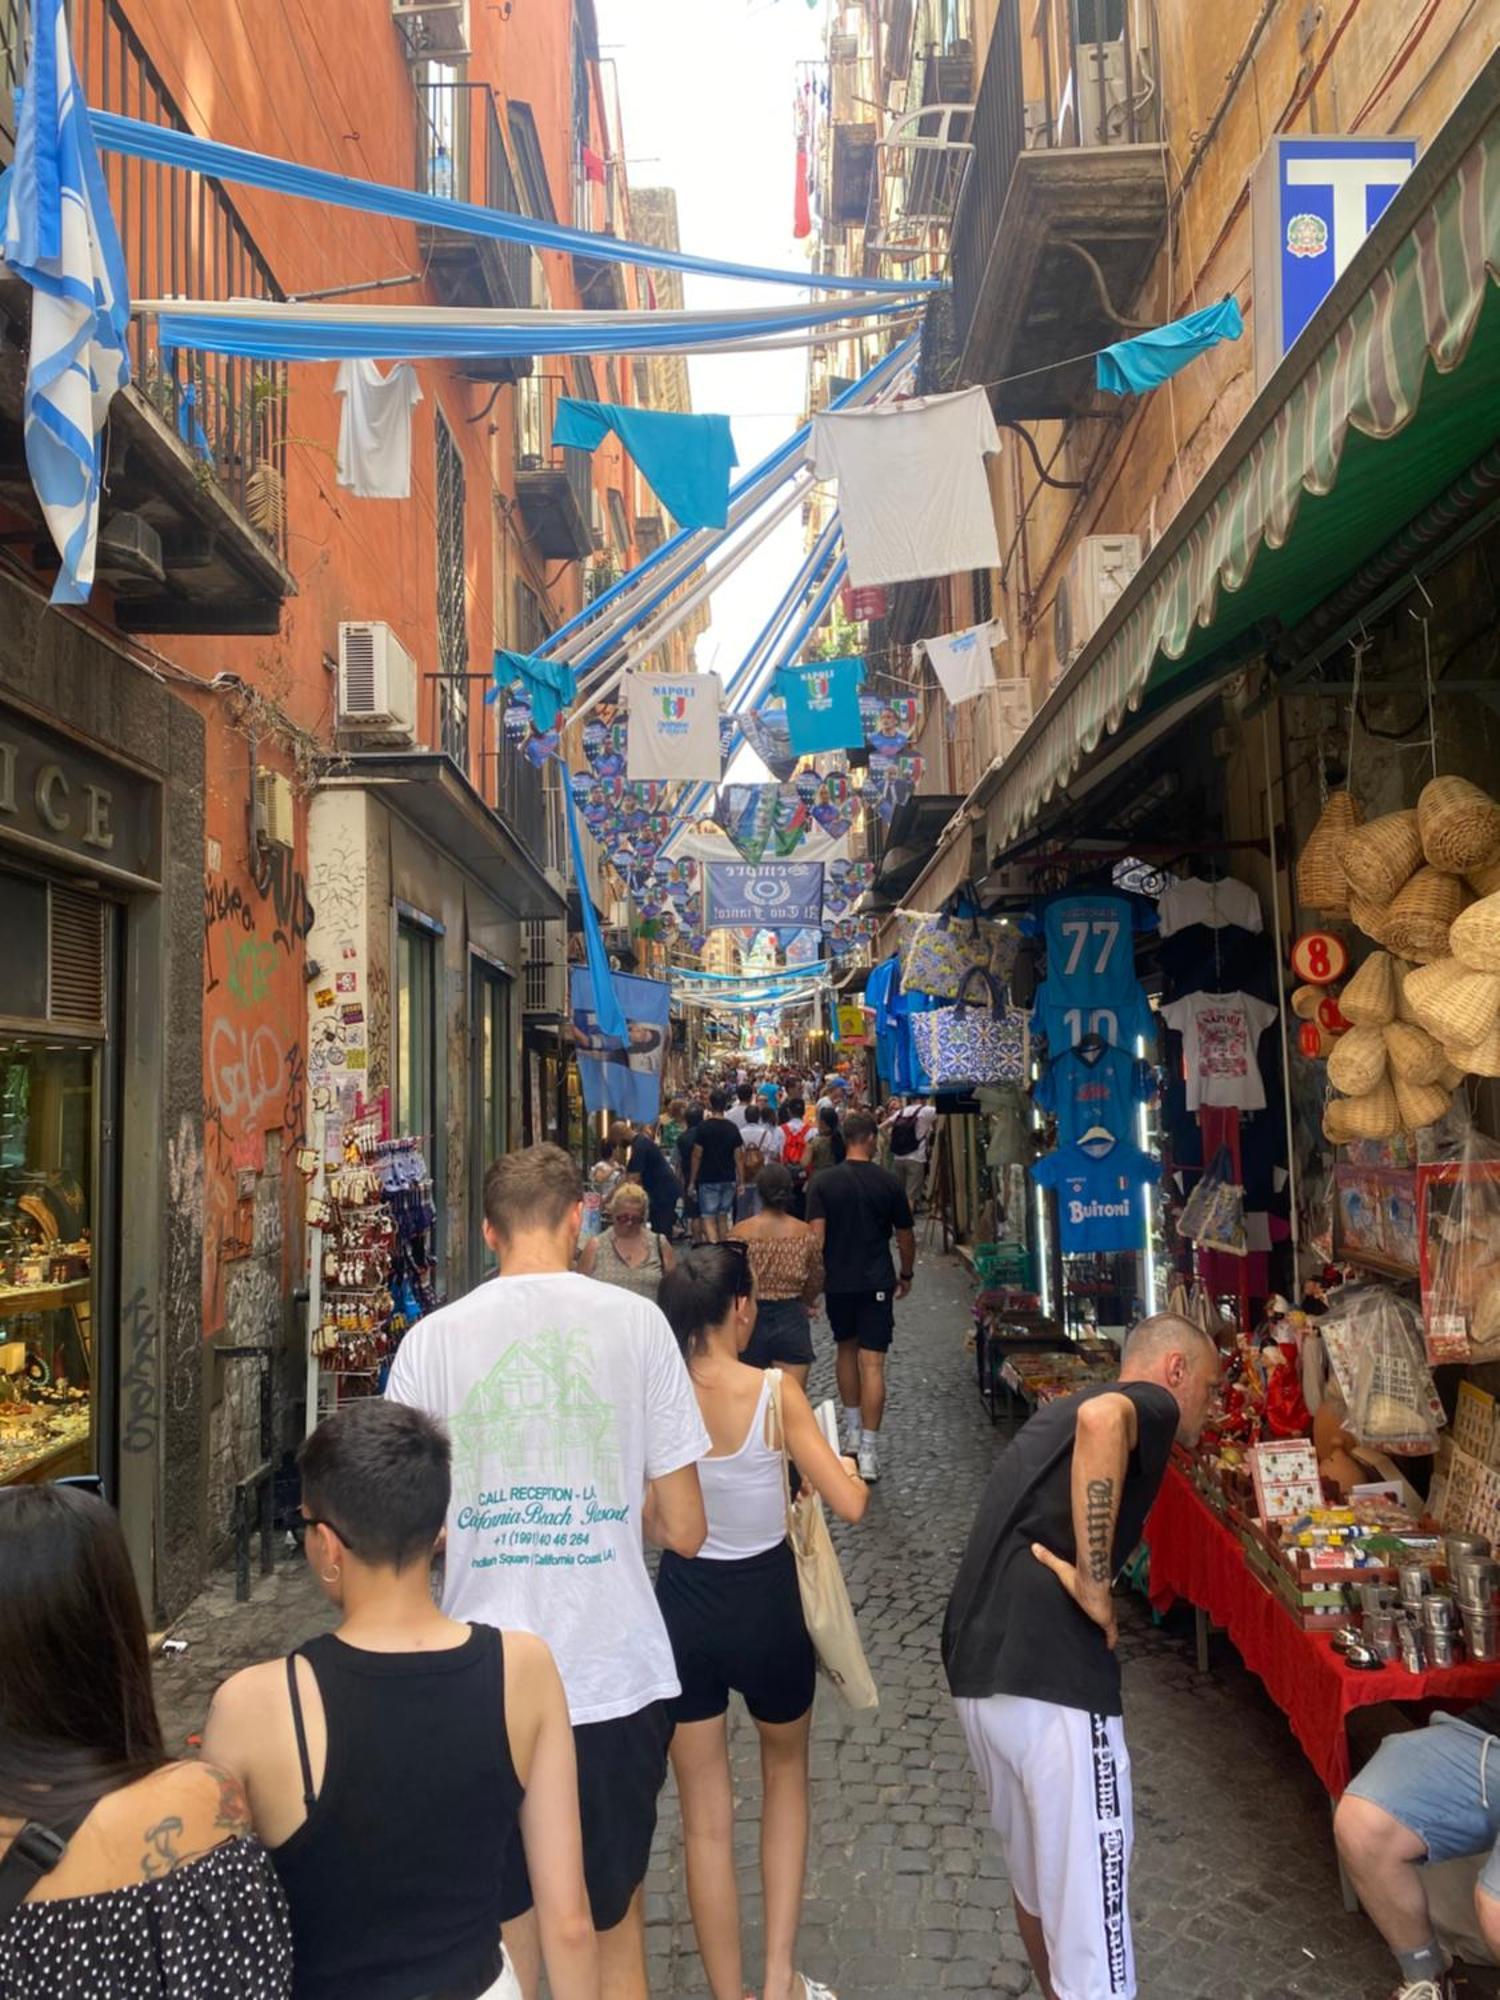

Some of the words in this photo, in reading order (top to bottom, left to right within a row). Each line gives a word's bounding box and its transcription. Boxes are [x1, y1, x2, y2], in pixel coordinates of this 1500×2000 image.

[652, 686, 695, 697] NAPOLI
[1062, 922, 1119, 974] 77
[1308, 938, 1331, 977] 8
[478, 1488, 507, 1506] CALL
[510, 1486, 573, 1501] RECEPTION
[522, 1502, 573, 1526] Beach
